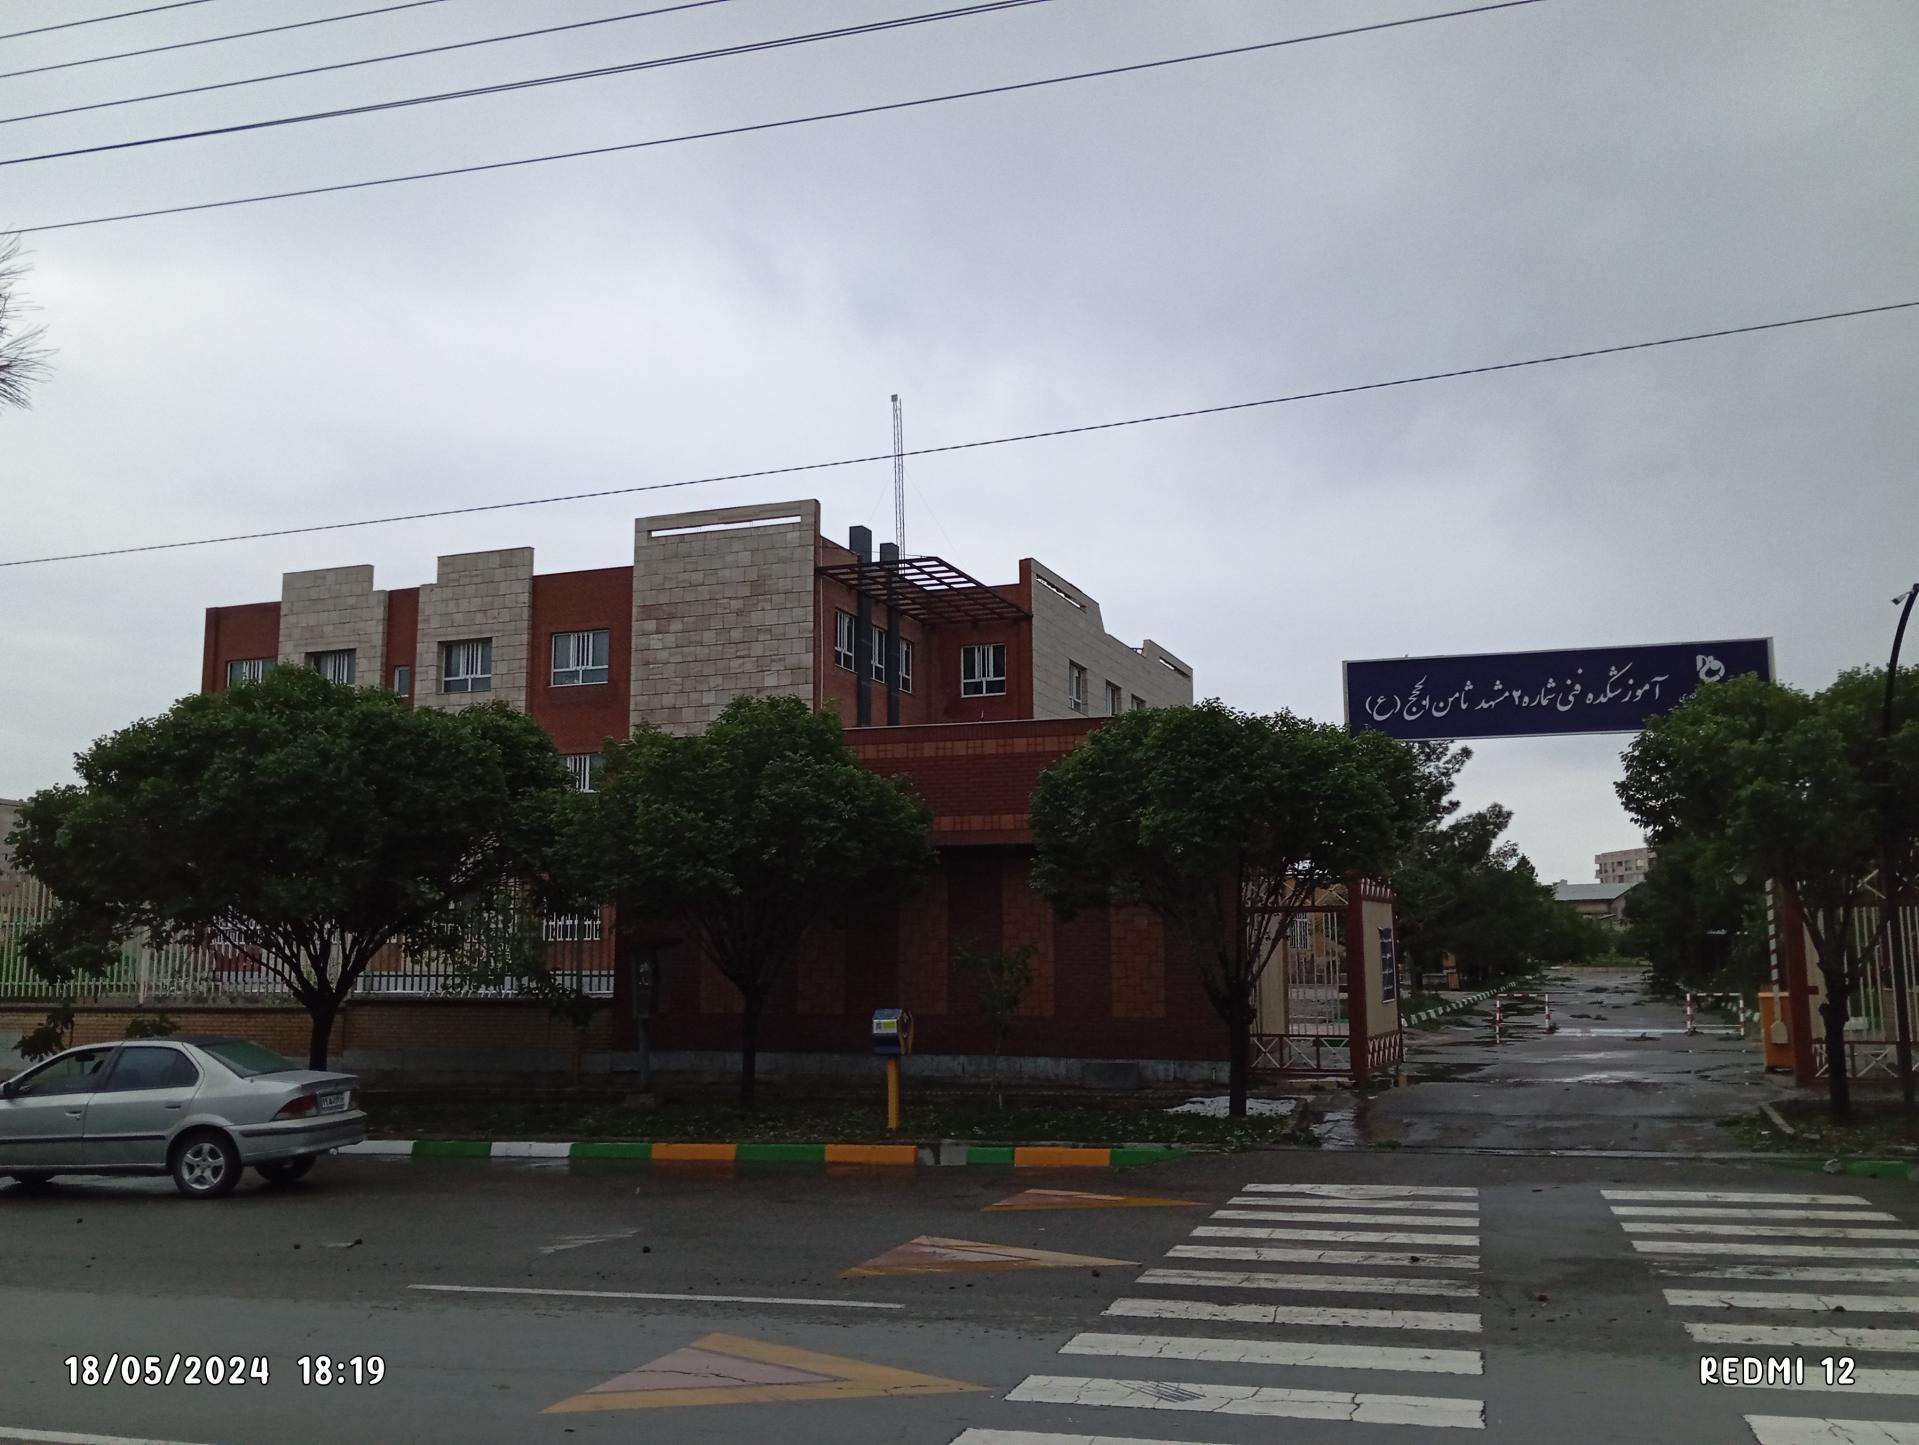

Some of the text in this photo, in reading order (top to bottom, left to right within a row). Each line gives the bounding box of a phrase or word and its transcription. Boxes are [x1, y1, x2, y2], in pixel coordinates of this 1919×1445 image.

[1431, 680, 1474, 718] ثامن
[1474, 679, 1510, 711] مشهد
[1556, 667, 1583, 712] فنی
[1585, 662, 1670, 704] آموزشکده
[1365, 694, 1401, 721] (ع)
